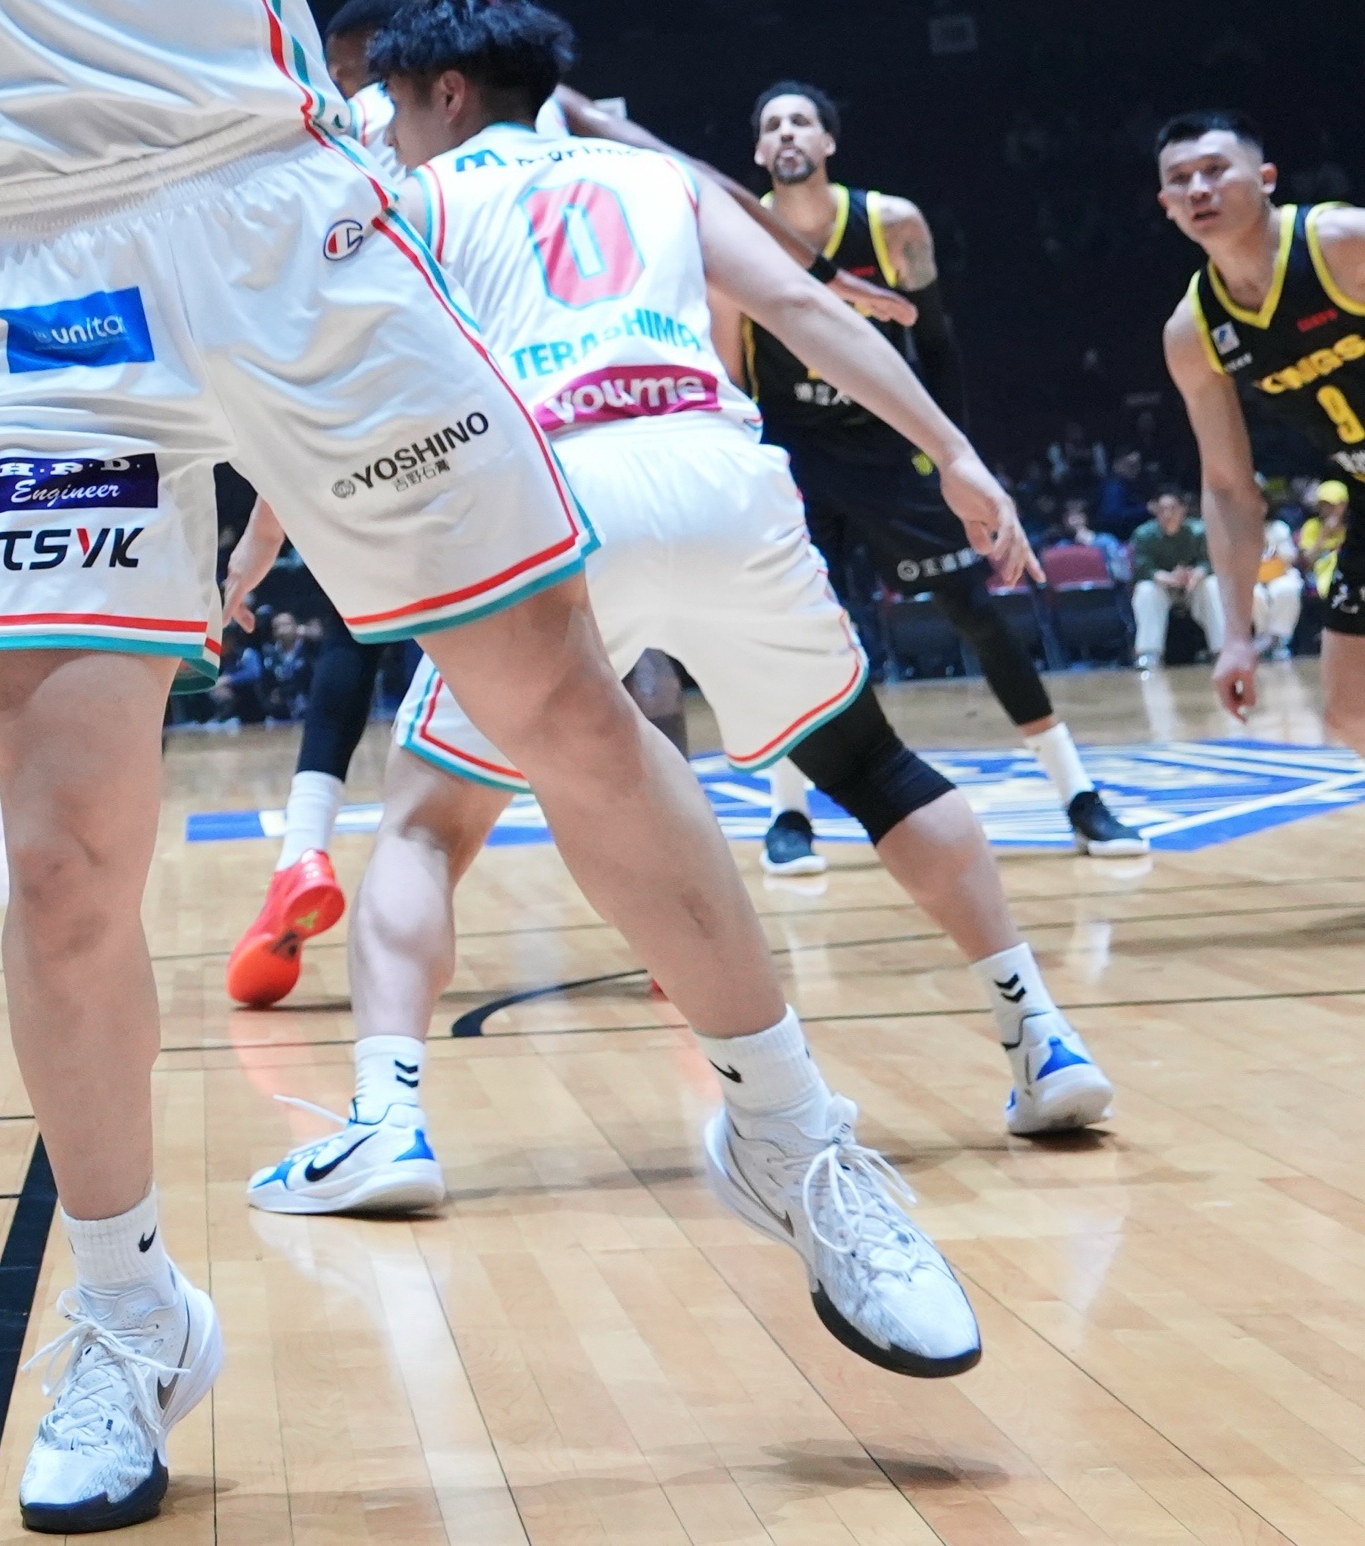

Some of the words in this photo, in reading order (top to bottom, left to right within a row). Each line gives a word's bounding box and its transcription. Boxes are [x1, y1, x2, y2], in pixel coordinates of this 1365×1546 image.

[520, 179, 645, 309] 0
[351, 411, 490, 490] YOSHINO
[10, 479, 120, 508] Engineer
